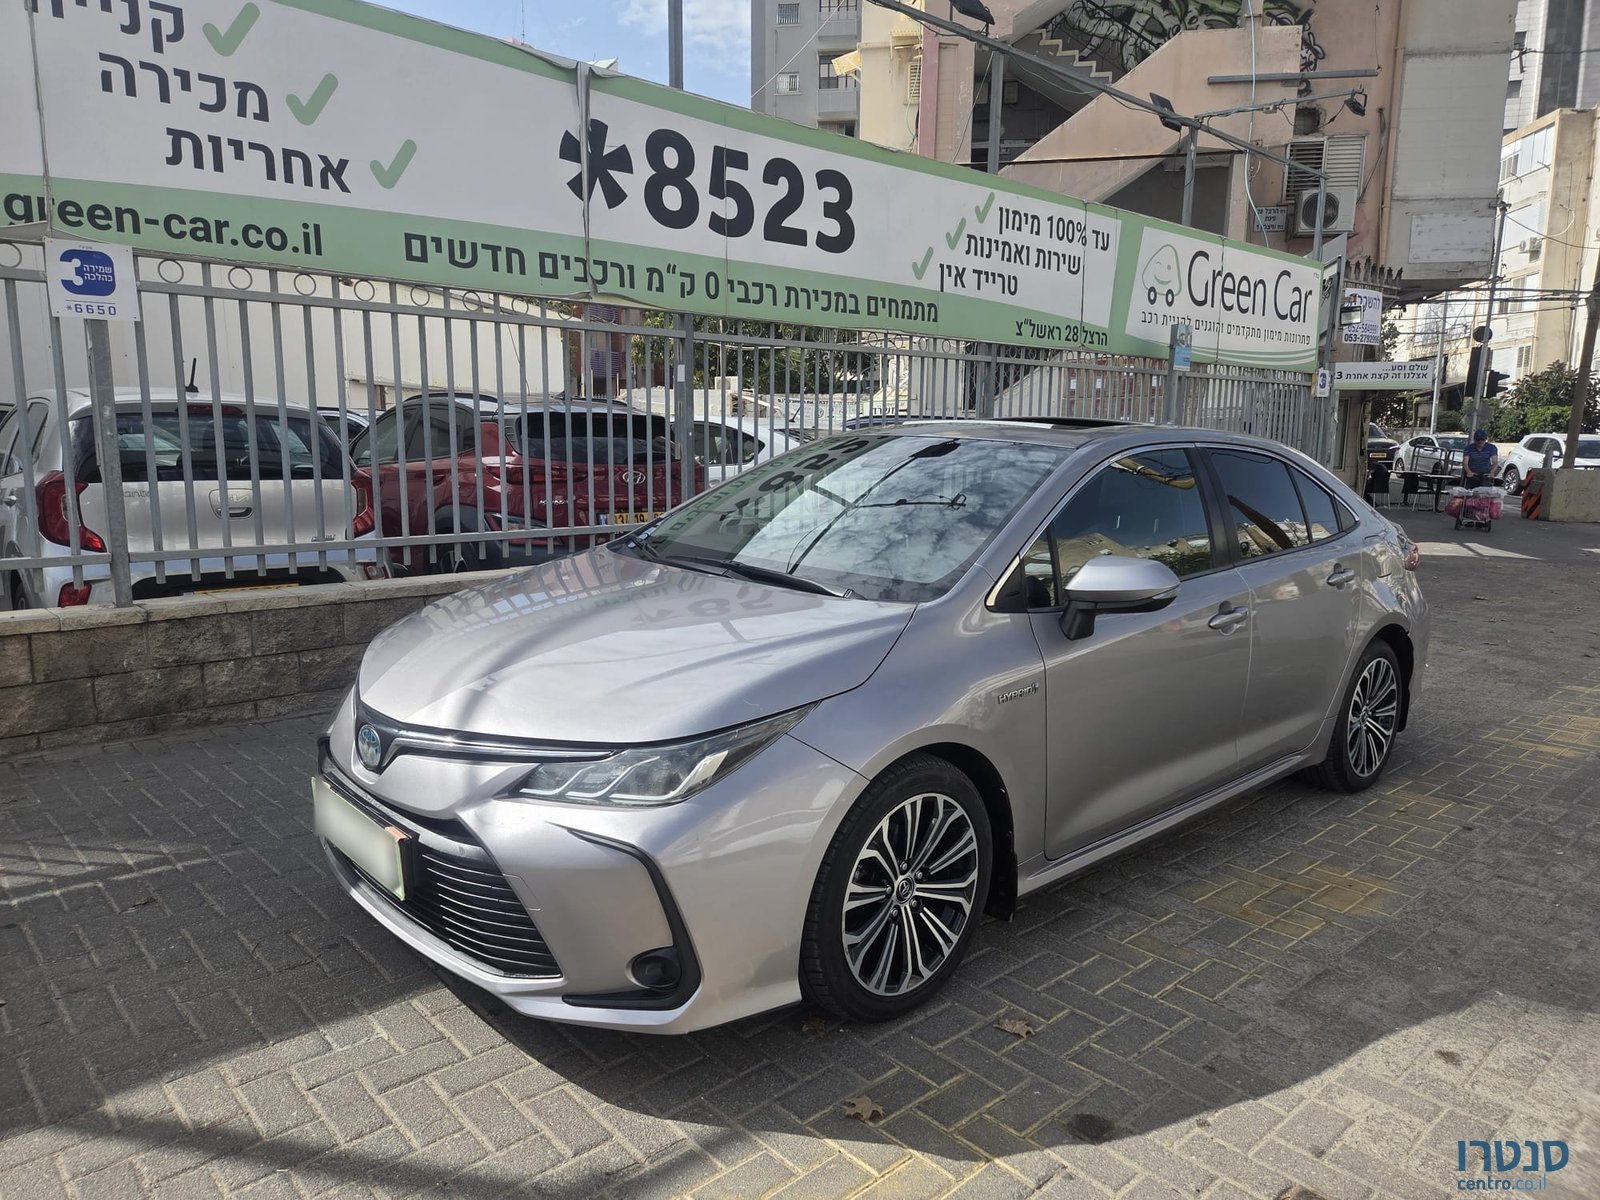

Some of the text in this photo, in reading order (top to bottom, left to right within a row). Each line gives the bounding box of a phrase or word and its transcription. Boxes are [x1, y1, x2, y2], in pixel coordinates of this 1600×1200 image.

[99, 52, 270, 123] מכירה
[165, 127, 352, 193] אחריות
[4, 192, 323, 257] green-car.co.il
[999, 207, 1110, 252] עד 100% מימון
[405, 231, 526, 276] חדשים
[965, 234, 1081, 276] שירות ואמינות
[83, 264, 112, 274] שמירה
[84, 273, 113, 282] כהלכה
[538, 251, 636, 290] ורכבים
[939, 264, 1018, 296] טרייד אין
[705, 271, 720, 300] 0
[728, 278, 778, 307] רכבי
[1188, 250, 1267, 317] Green
[1274, 270, 1313, 324] Car
[783, 286, 860, 315] במכירת
[866, 295, 938, 323] מתמחים
[1141, 311, 1159, 326] רכב
[1195, 320, 1224, 334] והוגנים
[1227, 324, 1262, 339] מתקדמים
[1065, 325, 1079, 343] 28
[1081, 326, 1107, 347] הרצל
[1263, 329, 1282, 342] מימון
[1284, 333, 1311, 346] פתרונות
[1371, 372, 1389, 381] קצת
